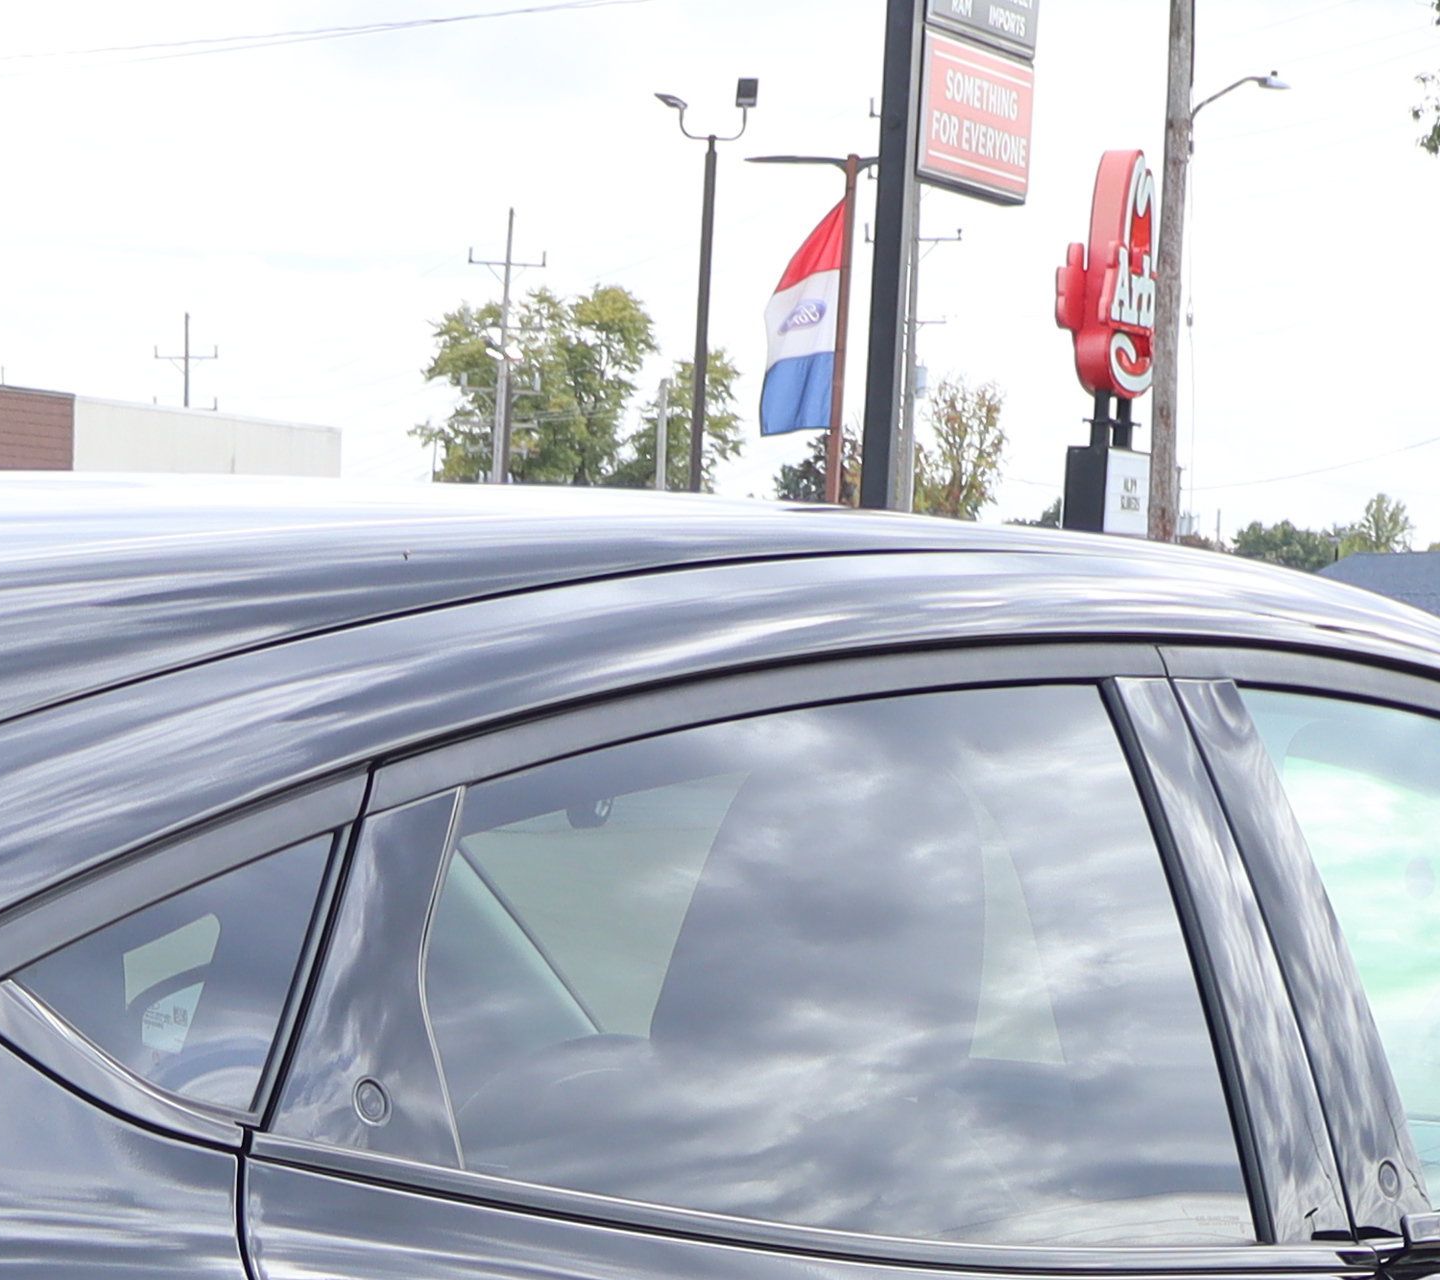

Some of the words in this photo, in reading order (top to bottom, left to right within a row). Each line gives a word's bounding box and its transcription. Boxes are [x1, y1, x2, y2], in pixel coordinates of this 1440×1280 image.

[988, 4, 1026, 37] IMPORTS
[946, 68, 1019, 121] SOMETHING
[931, 109, 959, 147] FOR
[961, 119, 1028, 169] EVERYONE
